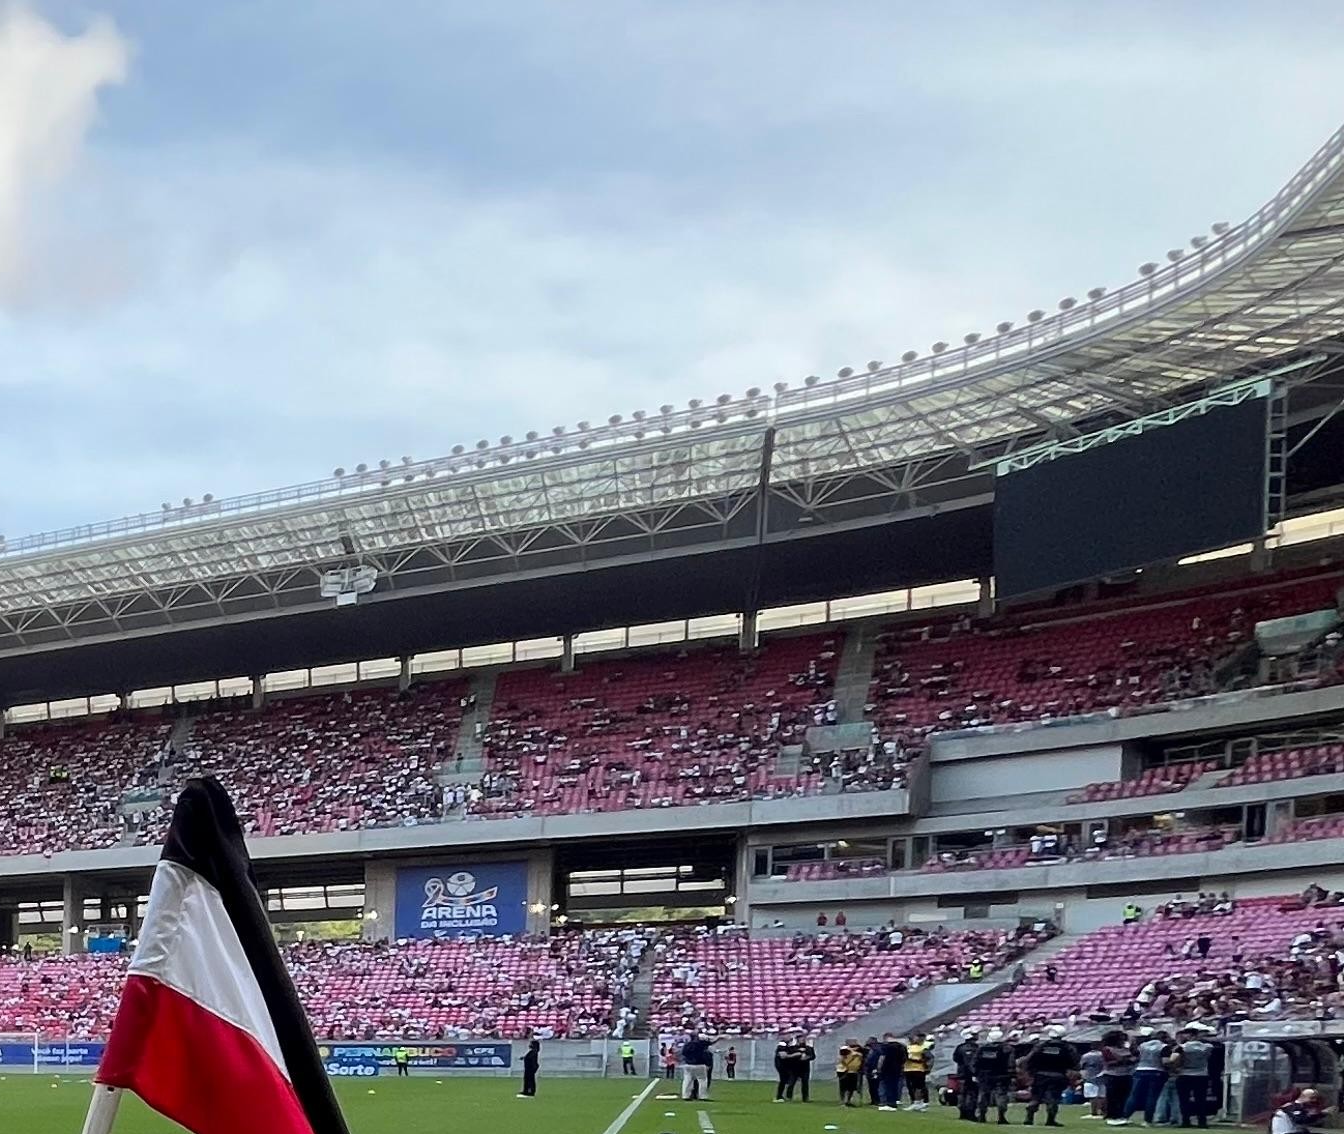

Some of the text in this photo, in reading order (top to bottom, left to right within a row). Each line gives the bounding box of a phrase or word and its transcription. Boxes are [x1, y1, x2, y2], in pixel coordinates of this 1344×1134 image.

[421, 904, 498, 920] ARENA
[420, 918, 498, 929] DA INCLUSÃO
[333, 1047, 457, 1057] PERNABUCO
[327, 1063, 376, 1076] Sorte
